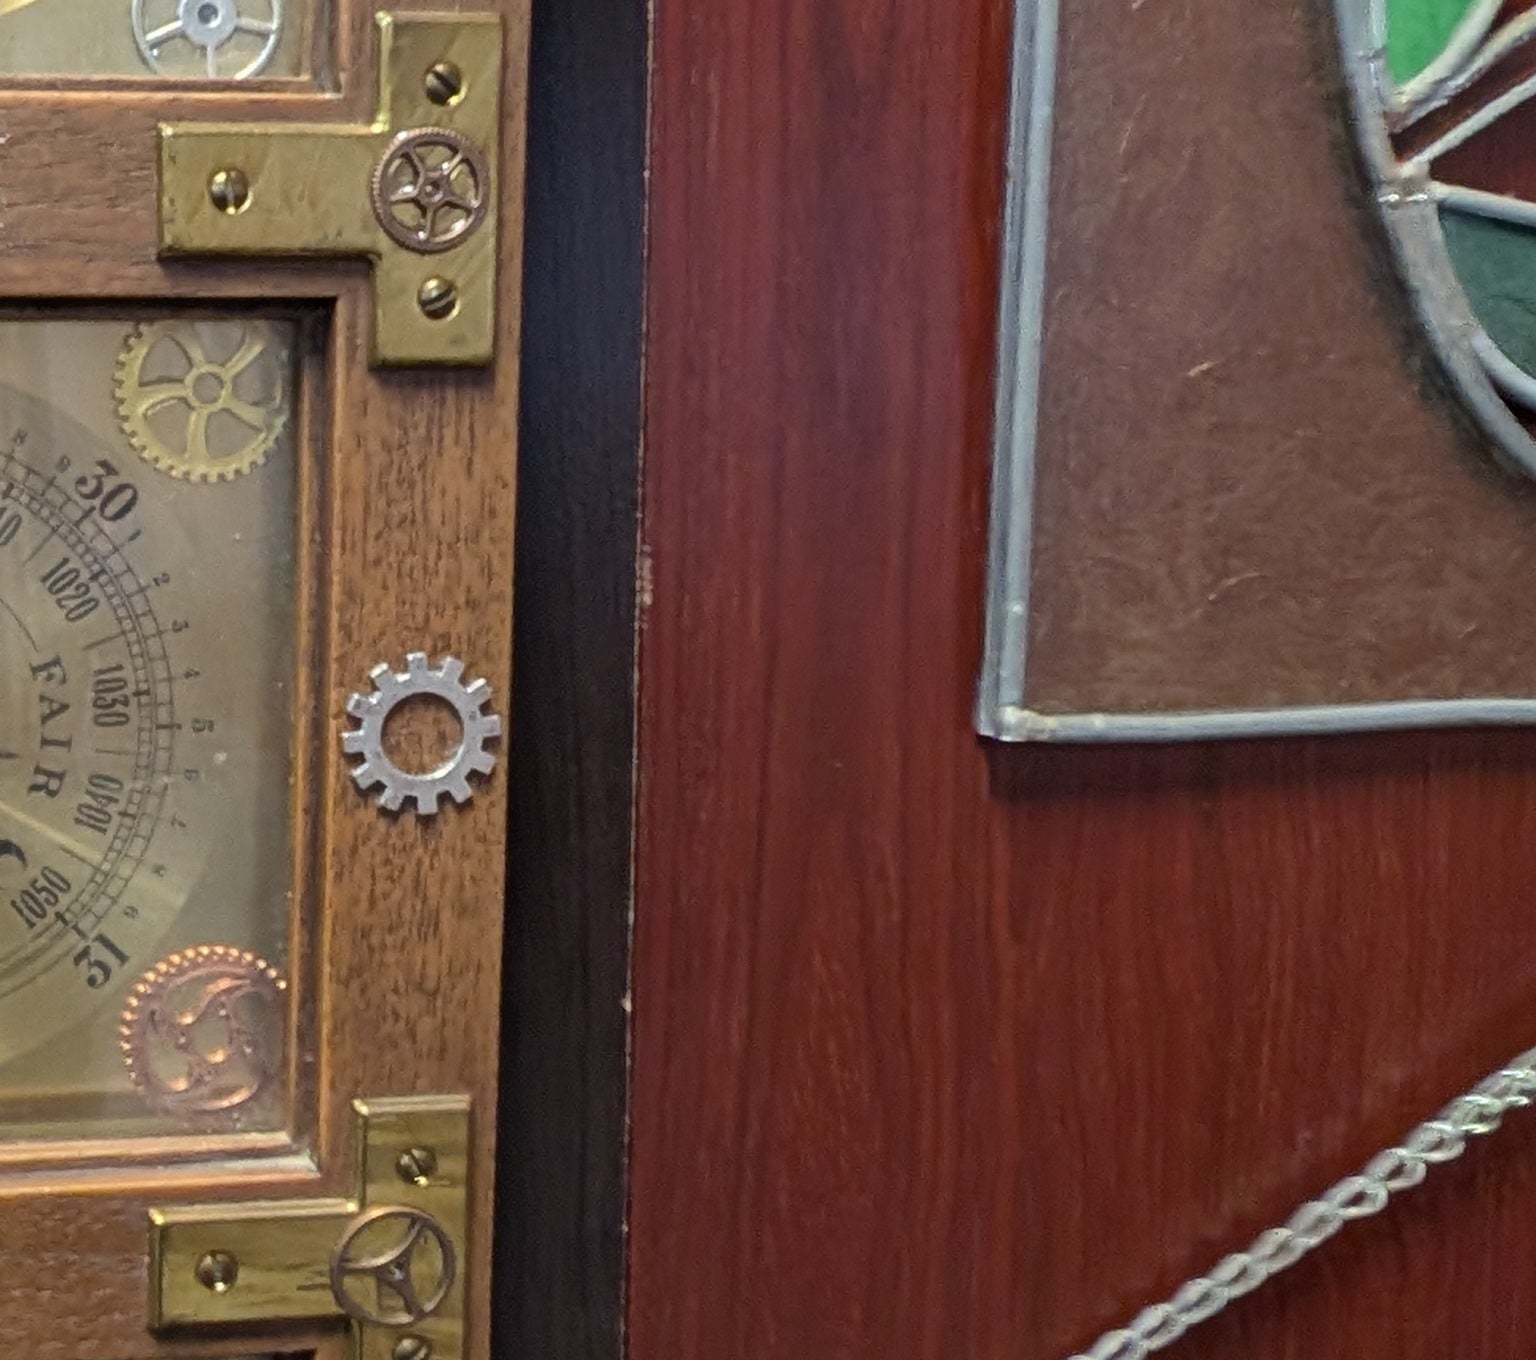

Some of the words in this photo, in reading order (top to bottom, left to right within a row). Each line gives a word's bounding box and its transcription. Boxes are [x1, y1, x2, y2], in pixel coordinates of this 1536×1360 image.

[74, 458, 140, 523] 30
[40, 557, 100, 623] 1020
[26, 654, 73, 799] FAIR
[92, 662, 131, 728] 1030
[73, 773, 125, 836] 1040
[10, 865, 71, 929] 1050
[72, 933, 131, 990] 31
